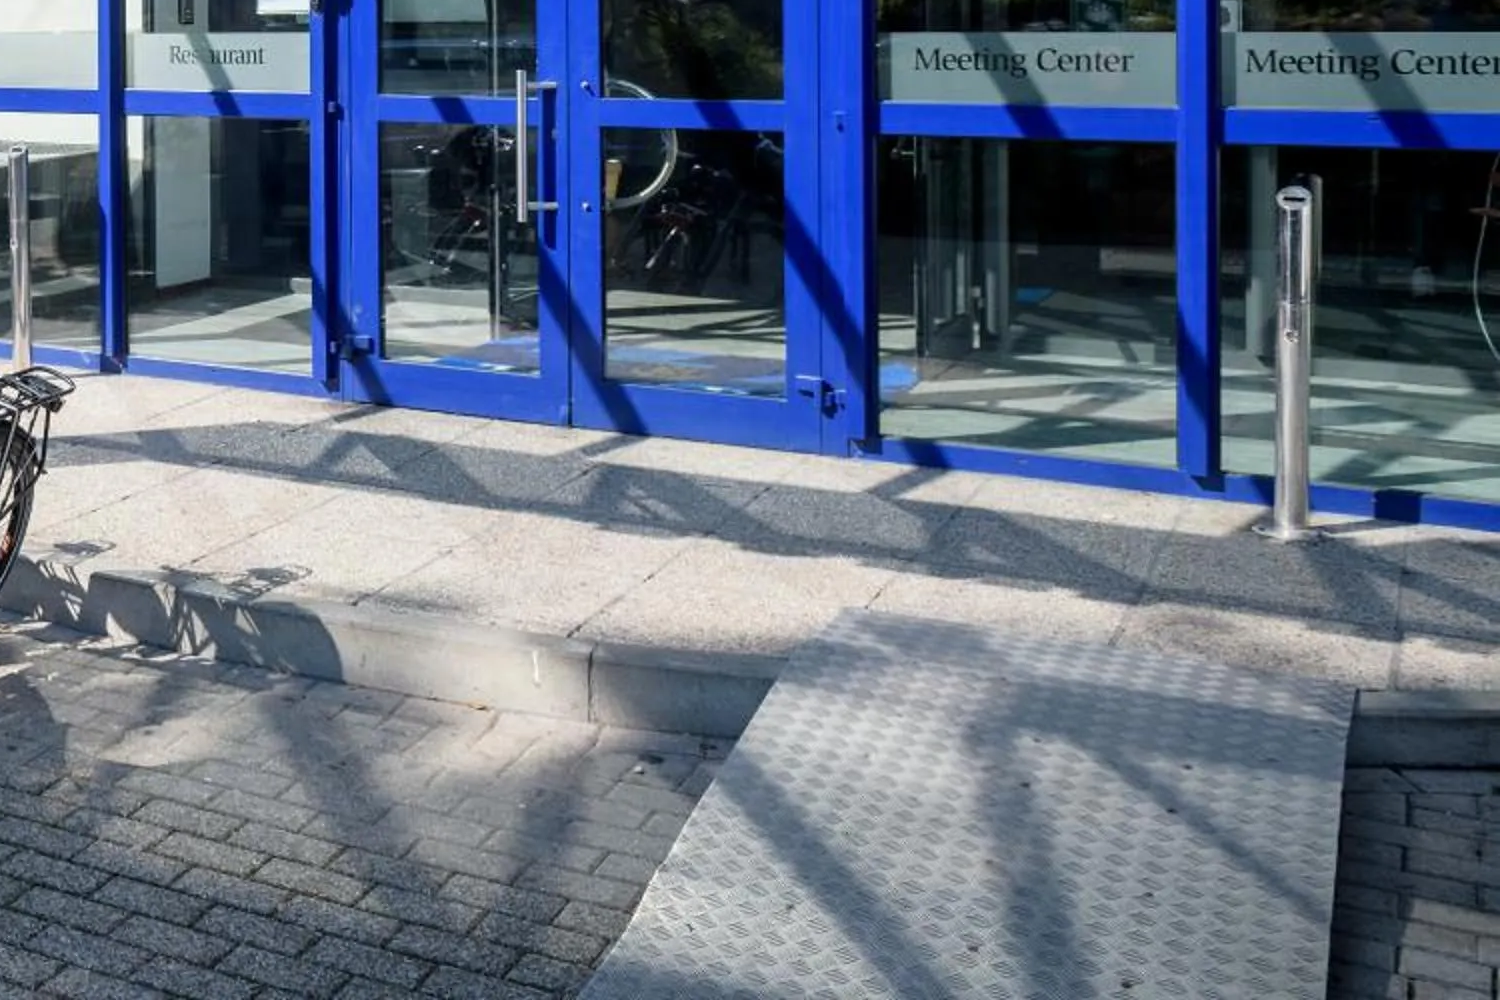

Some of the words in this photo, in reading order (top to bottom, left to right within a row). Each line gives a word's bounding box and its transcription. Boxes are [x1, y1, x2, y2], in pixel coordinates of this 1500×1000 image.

[169, 45, 265, 65] Resurant
[914, 47, 1028, 78] Meeting
[1036, 47, 1135, 73] Center
[1246, 47, 1381, 81] Meeting
